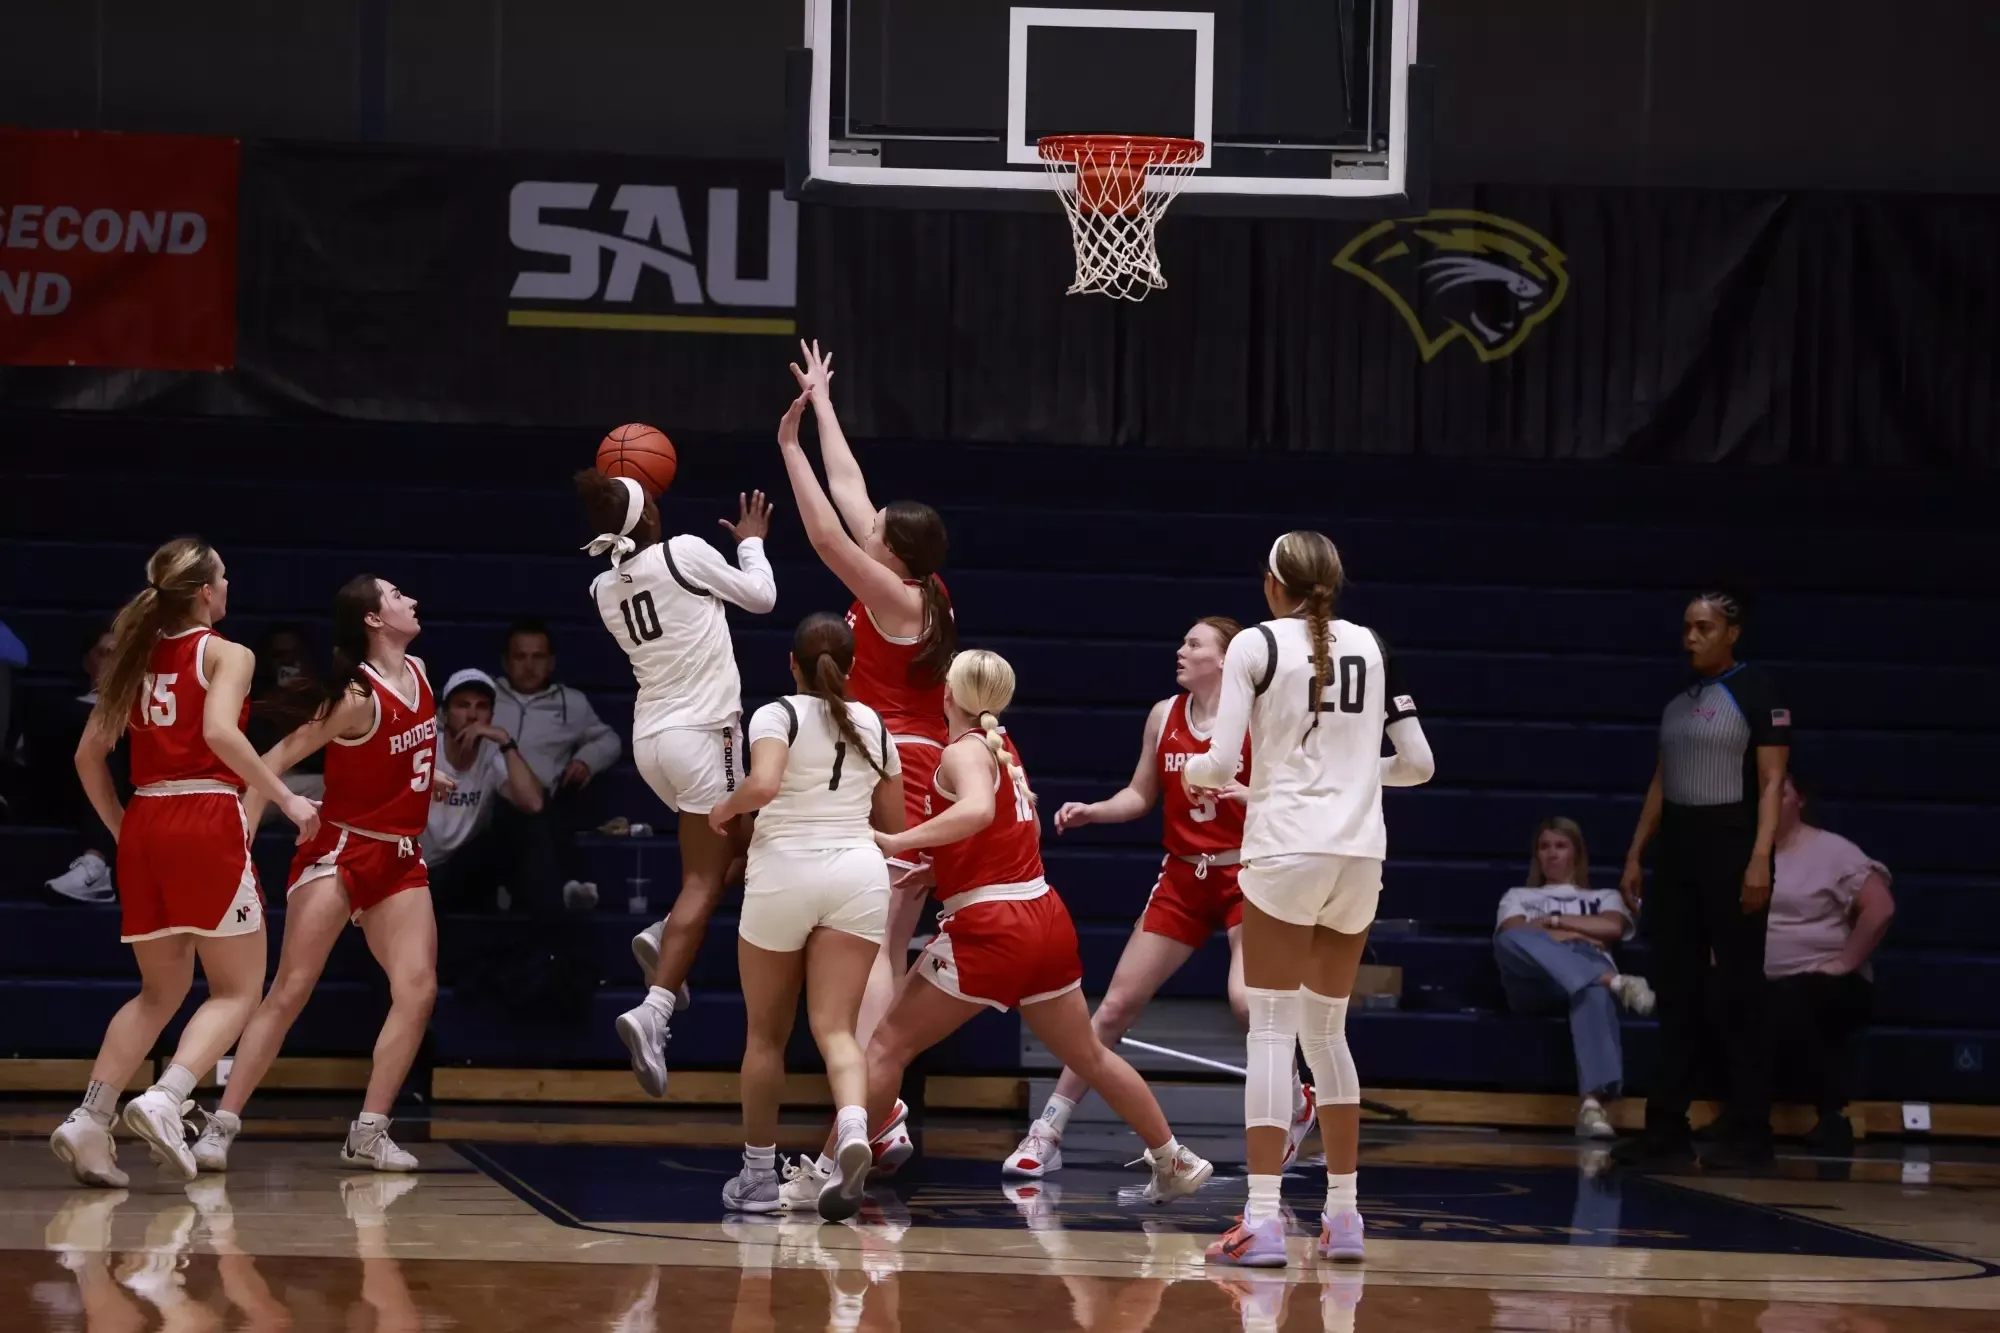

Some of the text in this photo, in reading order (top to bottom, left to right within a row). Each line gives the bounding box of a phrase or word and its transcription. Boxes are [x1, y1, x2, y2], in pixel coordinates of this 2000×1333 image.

[0, 204, 208, 255] ECOND
[509, 180, 798, 307] SAU
[620, 590, 663, 646] 10
[141, 672, 178, 727] 15
[1307, 655, 1366, 713] 20
[410, 747, 433, 793] 5
[828, 741, 846, 791] 1
